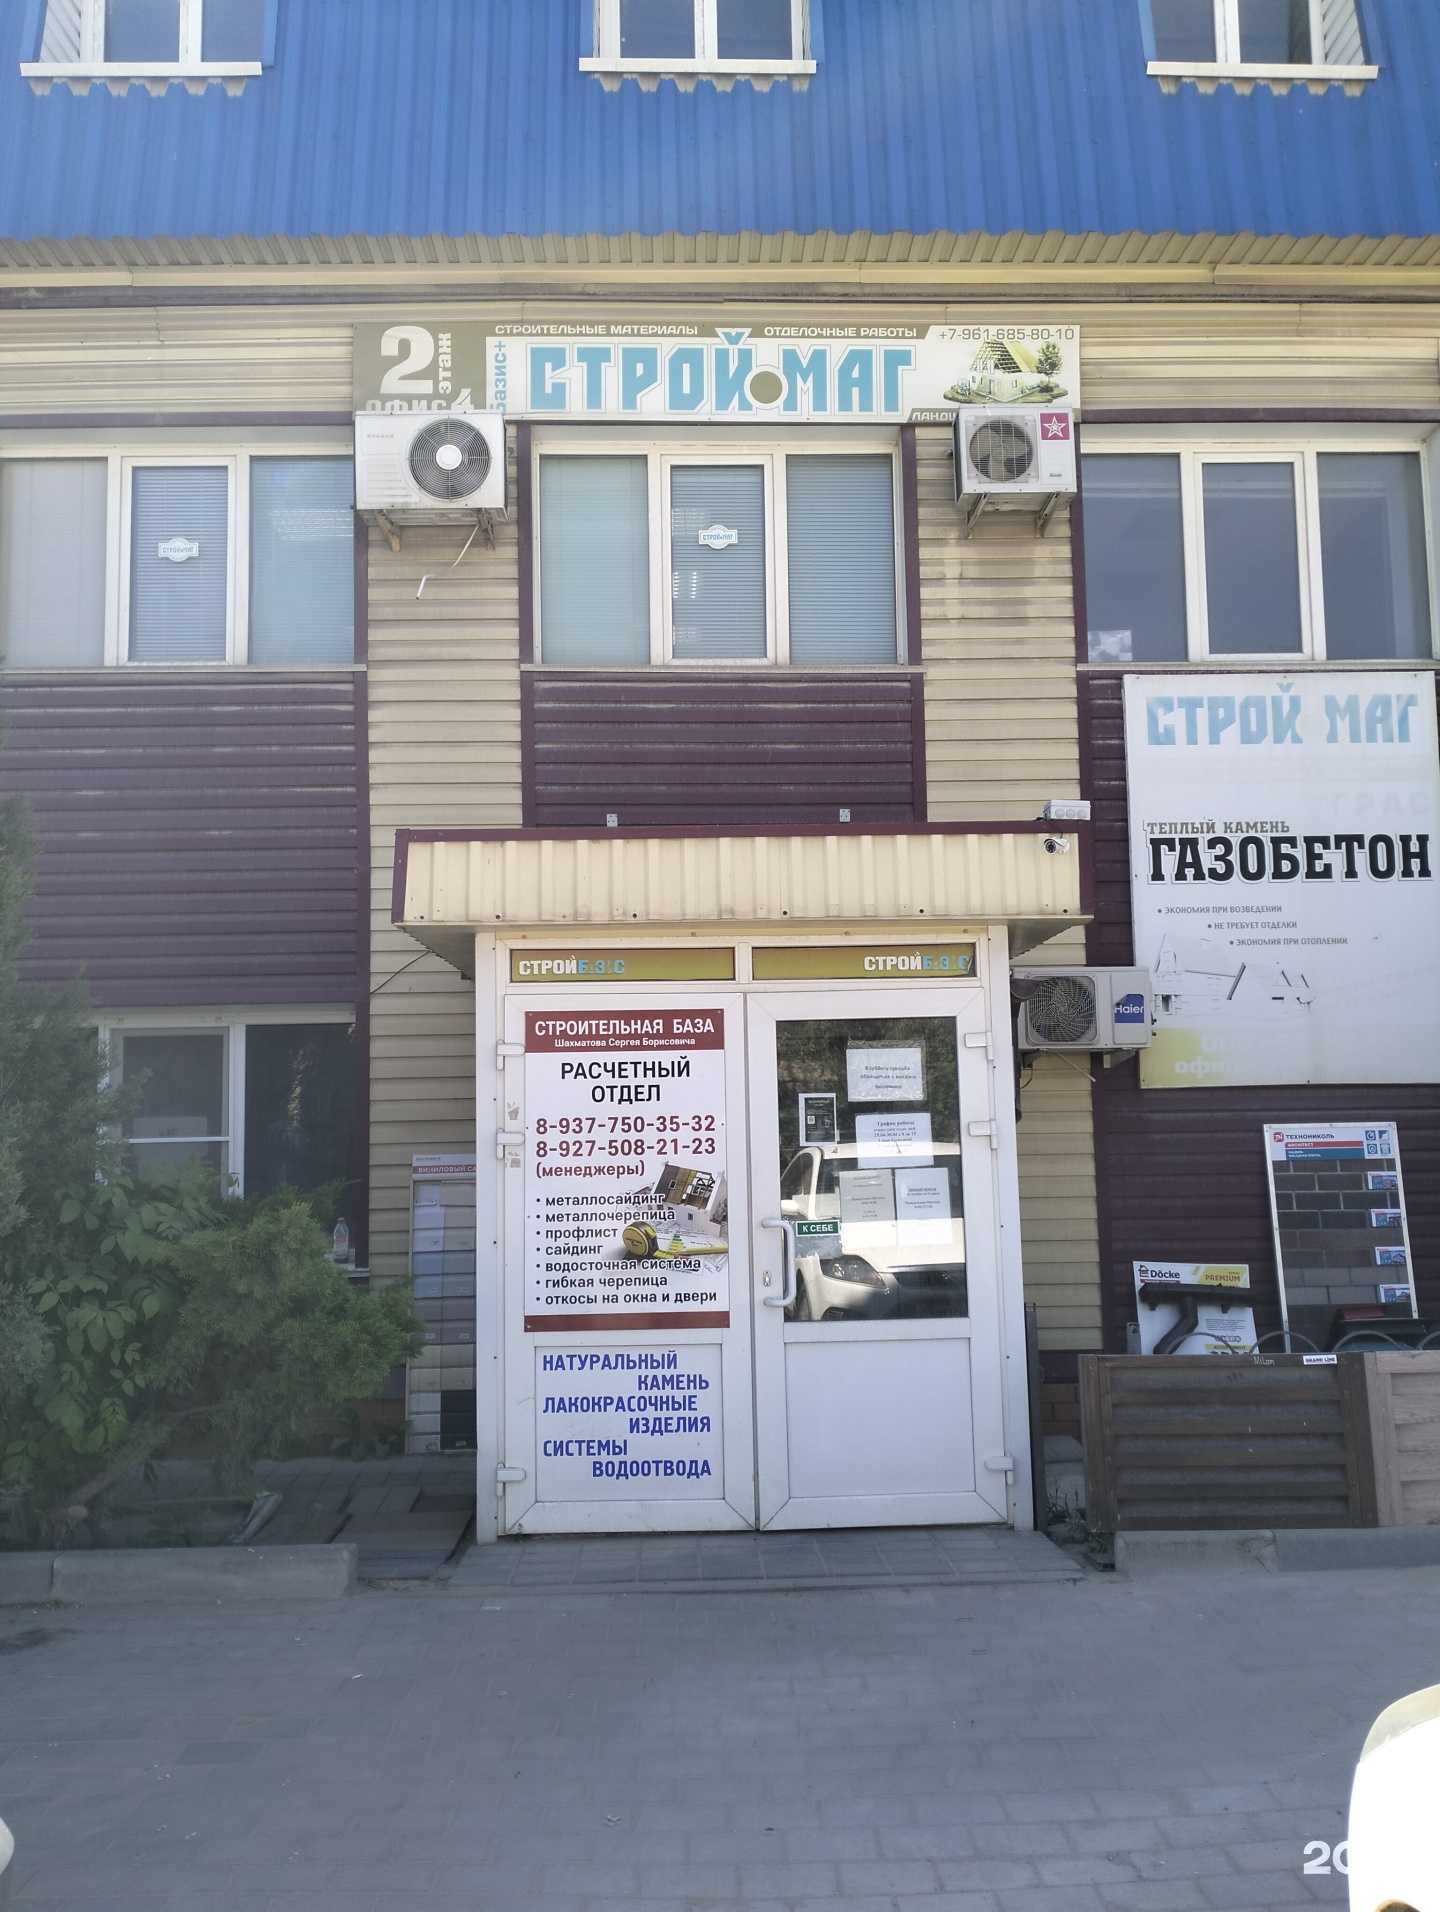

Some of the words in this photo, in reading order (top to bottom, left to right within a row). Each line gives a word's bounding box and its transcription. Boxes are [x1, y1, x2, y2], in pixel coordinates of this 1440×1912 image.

[495, 325, 608, 336] СТРОИТЕЛЬНЫЕ
[610, 325, 698, 336] МАТЕРИАЛЫ
[764, 326, 857, 337] ОТДЕЛОЧНЫЕ
[860, 326, 917, 337] РАБОТЫ
[938, 327, 1075, 340] +7-961-685-80-10
[380, 325, 435, 395] 2
[438, 332, 452, 395] этаж
[1146, 682, 1303, 746] СТРОЙ
[1324, 693, 1419, 744] МАГ
[1146, 819, 1217, 835] ТЕПЛЫЙ
[1223, 820, 1291, 834] КАМЕНЬ
[1149, 833, 1432, 882] ГАЗОБЕТОН
[1164, 906, 1210, 914] ЭКОНОМИЯ
[1229, 905, 1283, 914] ВОЗВЕДЕНИИ
[1214, 922, 1225, 930] НЕ
[1226, 921, 1259, 930] ТРЕБУЕТ
[1260, 921, 1298, 930] ОТДЕЛКИ
[1236, 938, 1281, 946] ЭКОНОМИЯ
[1300, 937, 1349, 945] ОТОПЛЕНИИ
[535, 1019, 664, 1036] СТРОИТЕЛЬНАЯ
[672, 1018, 715, 1035] БАЗА
[555, 1039, 607, 1048] Шахматова
[608, 1038, 641, 1048] Сергея
[643, 1037, 696, 1047] Борисовича
[561, 1056, 691, 1080] РАСЧЕТНЫЙ
[591, 1084, 661, 1104] ОТДЕЛ
[536, 1114, 716, 1135] 8-937-750-35-32
[536, 1137, 716, 1158] 8-927-508-21-23
[536, 1160, 646, 1178] (менеджеры)
[545, 1192, 664, 1207] металлосайдинг
[545, 1209, 675, 1224] металлочерепица
[545, 1226, 618, 1242] профлист
[802, 1225, 808, 1233] К
[810, 1224, 834, 1232] СЕБЕ
[545, 1243, 604, 1256] сайдинг
[545, 1260, 637, 1273] водосточная
[641, 1259, 701, 1270] система
[545, 1276, 594, 1289] гибкая
[599, 1275, 668, 1290] черепица
[545, 1293, 598, 1305] откосы
[602, 1293, 619, 1304] на
[623, 1292, 657, 1304] окна
[662, 1293, 669, 1303] и
[674, 1291, 718, 1305] двери
[543, 1350, 678, 1371] НАТУРАЛЬНЫЙ
[637, 1374, 710, 1391] КАМЕНЬ
[542, 1395, 698, 1413] ЛАКОКРАСОЧНЫЕ
[629, 1416, 711, 1436] ИЗДЕЛИЯ
[543, 1439, 628, 1457] СИСТЕМЫ
[592, 1459, 712, 1480] ВОДООТВОДА
